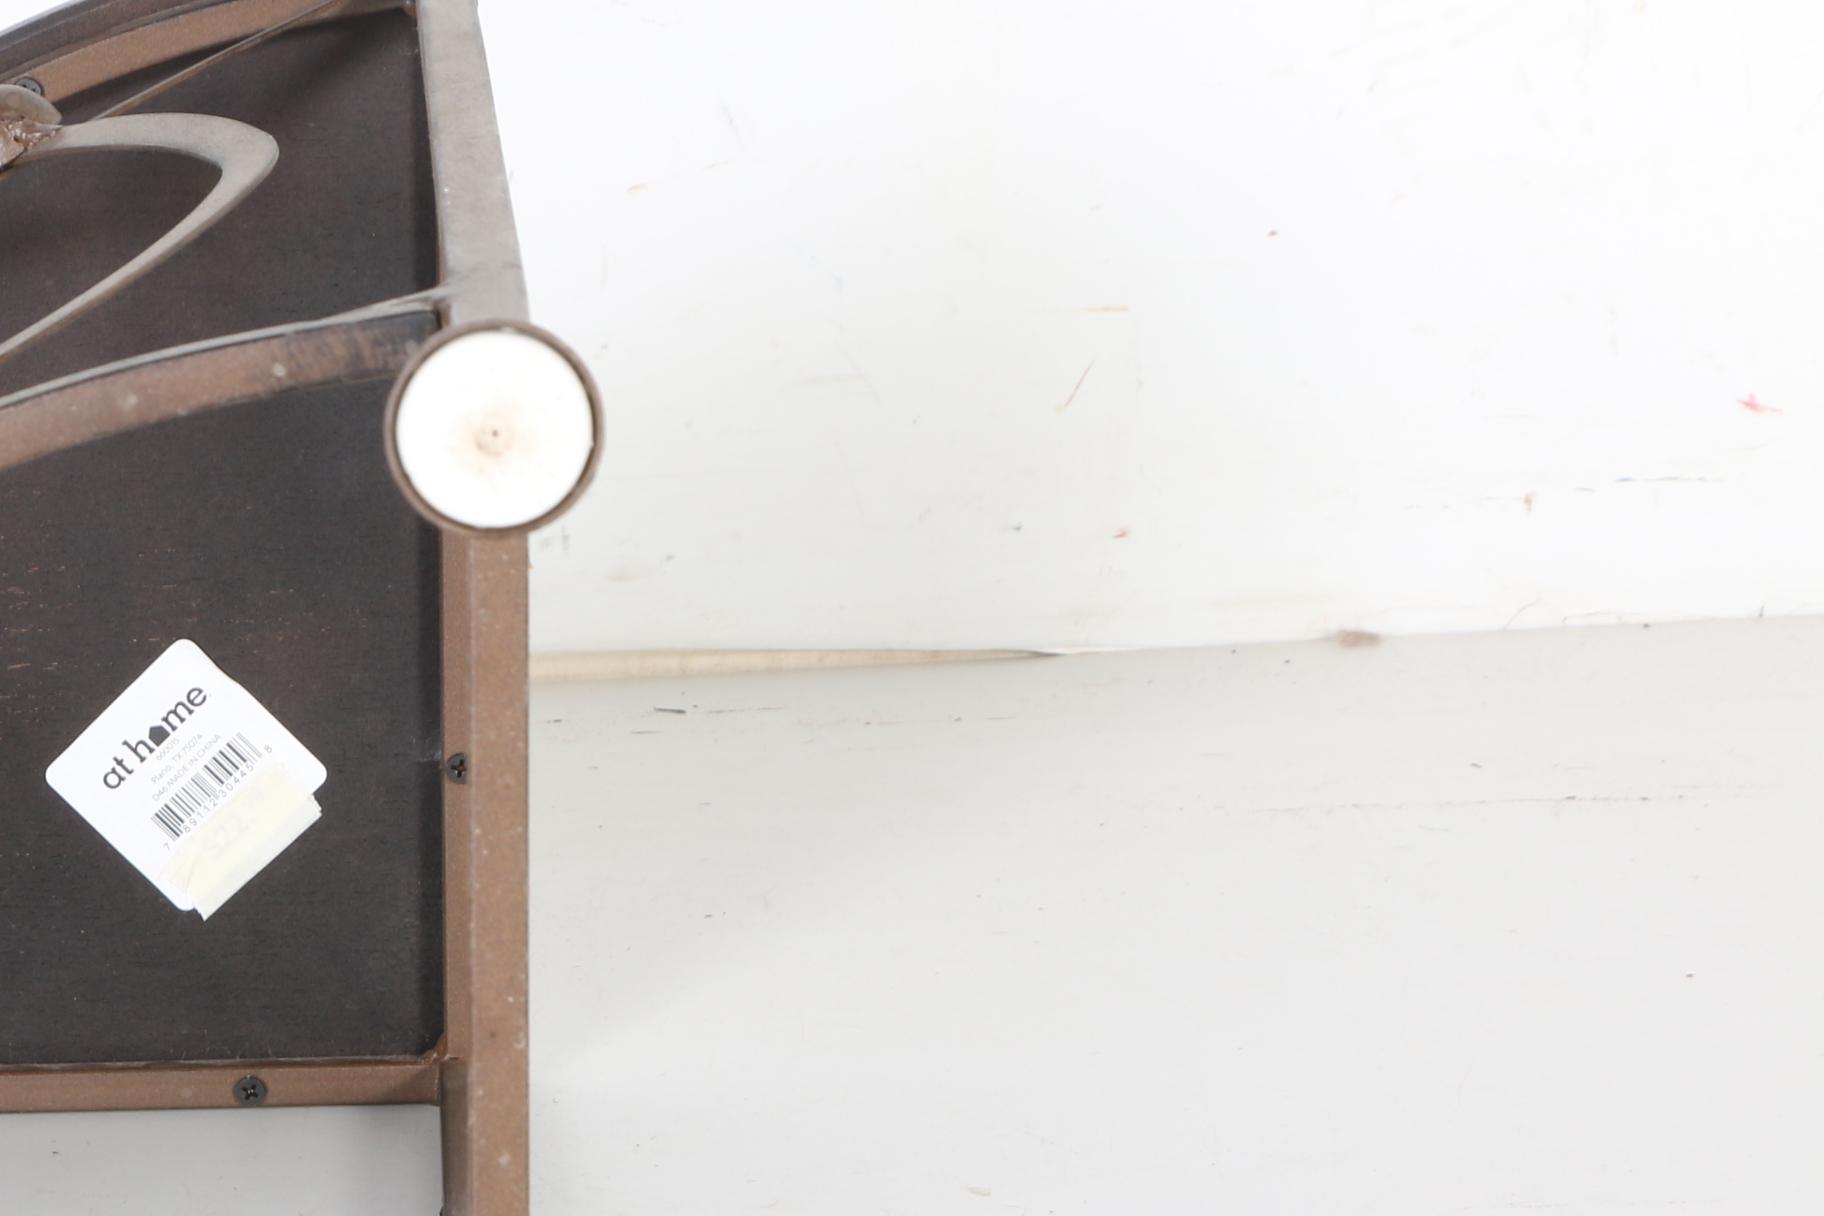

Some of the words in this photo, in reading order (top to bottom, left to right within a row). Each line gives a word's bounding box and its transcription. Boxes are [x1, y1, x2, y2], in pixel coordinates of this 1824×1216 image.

[103, 756, 134, 789] at
[166, 764, 189, 788] MADE
[188, 756, 199, 767] IN
[196, 734, 221, 758] CHINA
